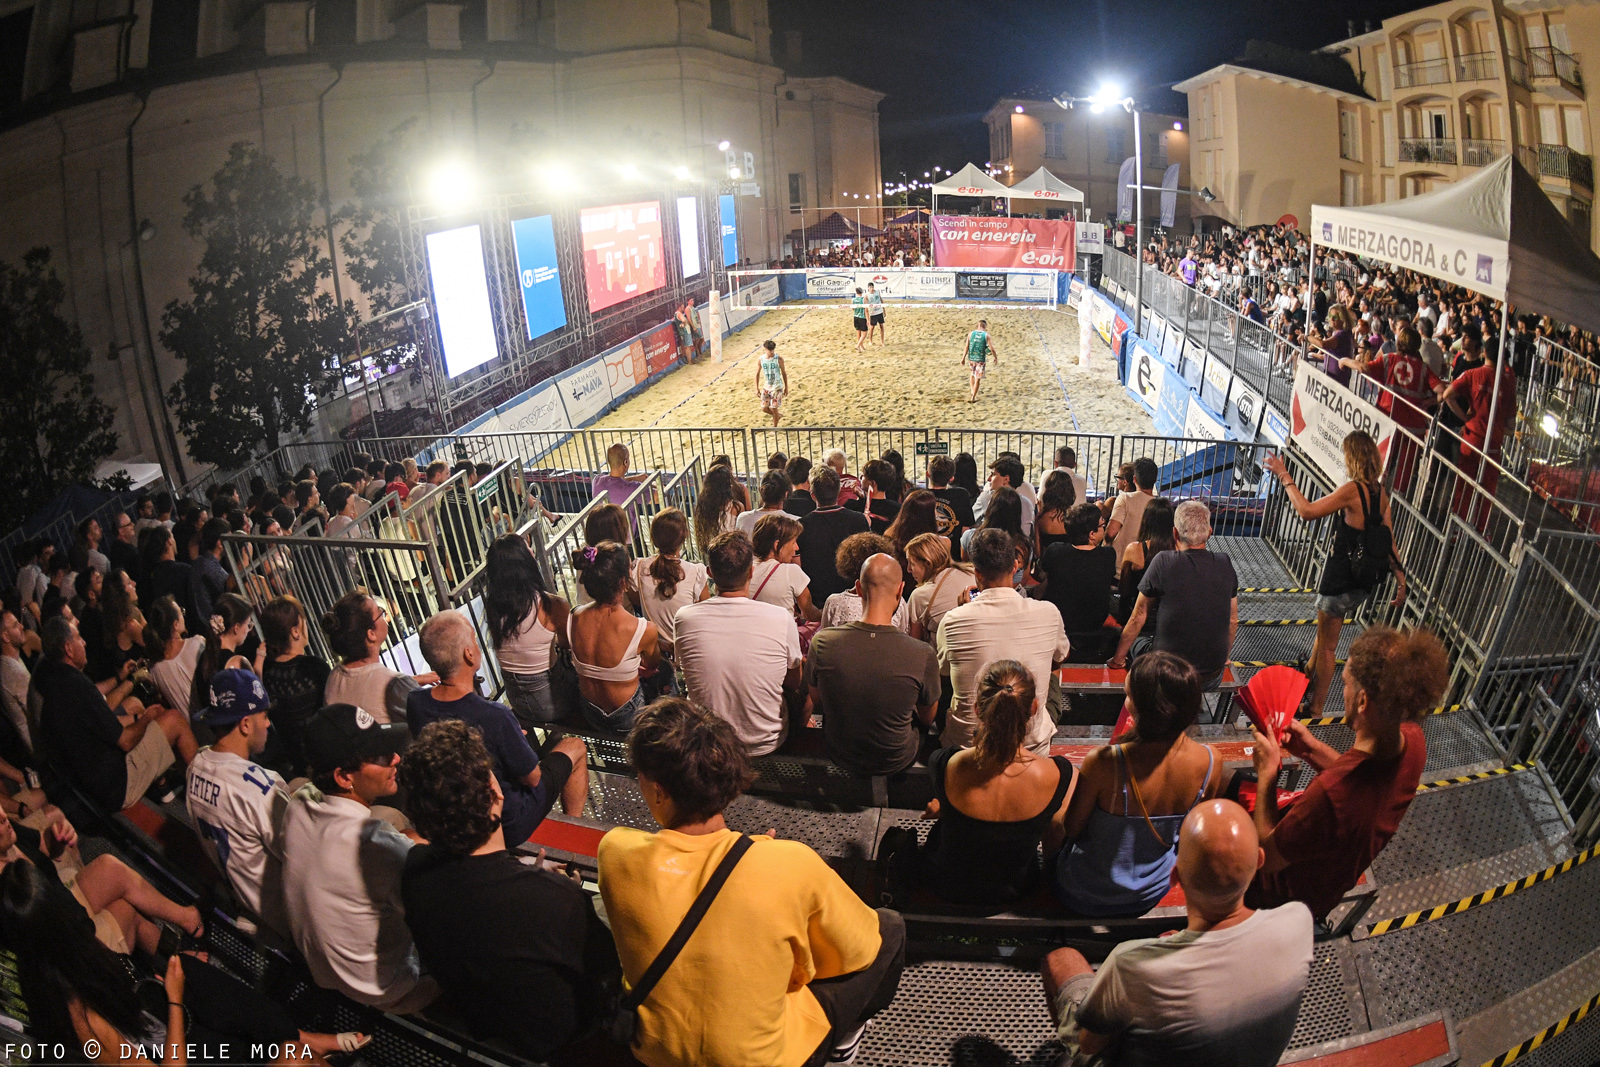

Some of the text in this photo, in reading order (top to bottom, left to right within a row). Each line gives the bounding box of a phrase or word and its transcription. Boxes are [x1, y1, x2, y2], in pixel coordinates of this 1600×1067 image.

[743, 151, 755, 179] B
[938, 218, 1008, 230] Scendi in campo
[939, 229, 1037, 246] con energia
[1337, 225, 1468, 277] MERZAGORA & C
[570, 368, 598, 387] FARMACIA
[582, 376, 603, 397] NAVA
[1304, 375, 1380, 445] MERZAGORA
